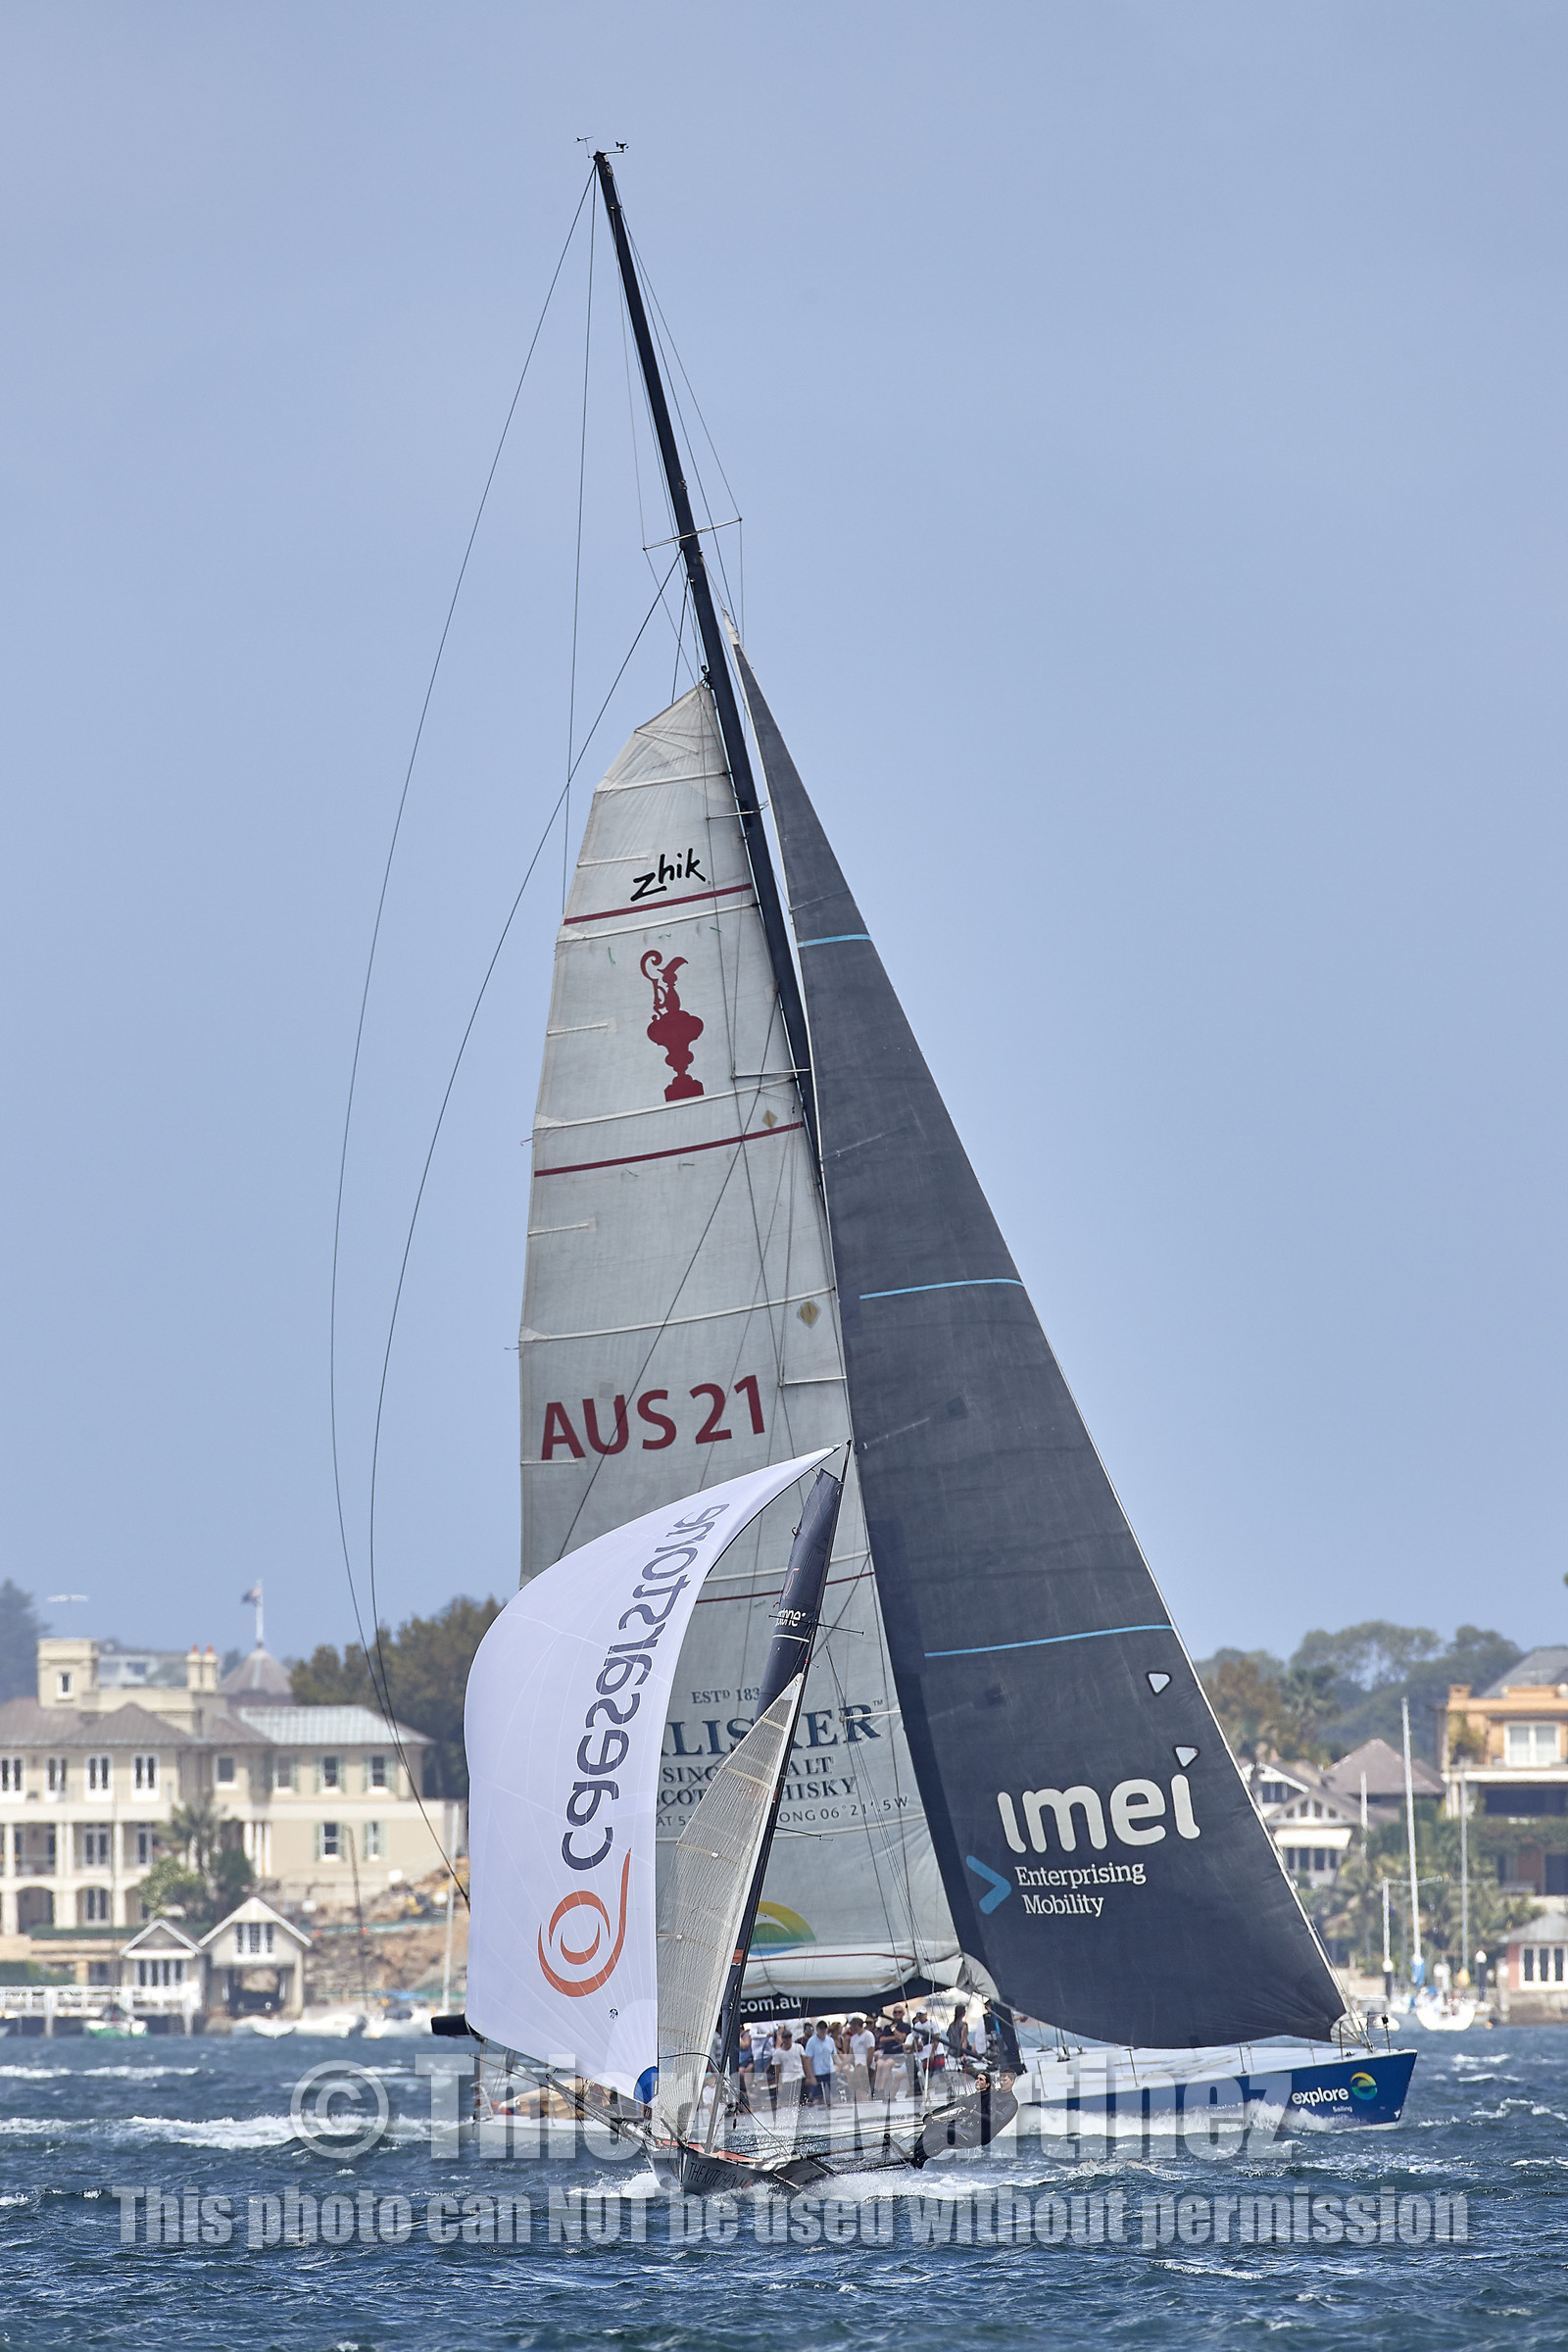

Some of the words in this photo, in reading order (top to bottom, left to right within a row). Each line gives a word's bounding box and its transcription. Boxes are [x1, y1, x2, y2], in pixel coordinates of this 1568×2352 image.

[630, 848, 707, 902] zhik
[541, 1389, 677, 1460] AUS
[690, 1375, 765, 1445] 21
[737, 1688, 760, 1702] 183
[662, 1704, 881, 1756] LISER
[787, 1755, 833, 1777] ALT
[657, 1788, 708, 1807] COT
[784, 1776, 856, 1800] HISKY
[657, 1815, 672, 1827] AT
[778, 1809, 816, 1823] ONG
[1014, 1862, 1147, 1889] Enterprising
[1021, 1893, 1105, 1918] Mobility
[1291, 2086, 1349, 2106] explore
[1332, 2105, 1353, 2114] Sailing
[688, 2162, 707, 2182] THE
